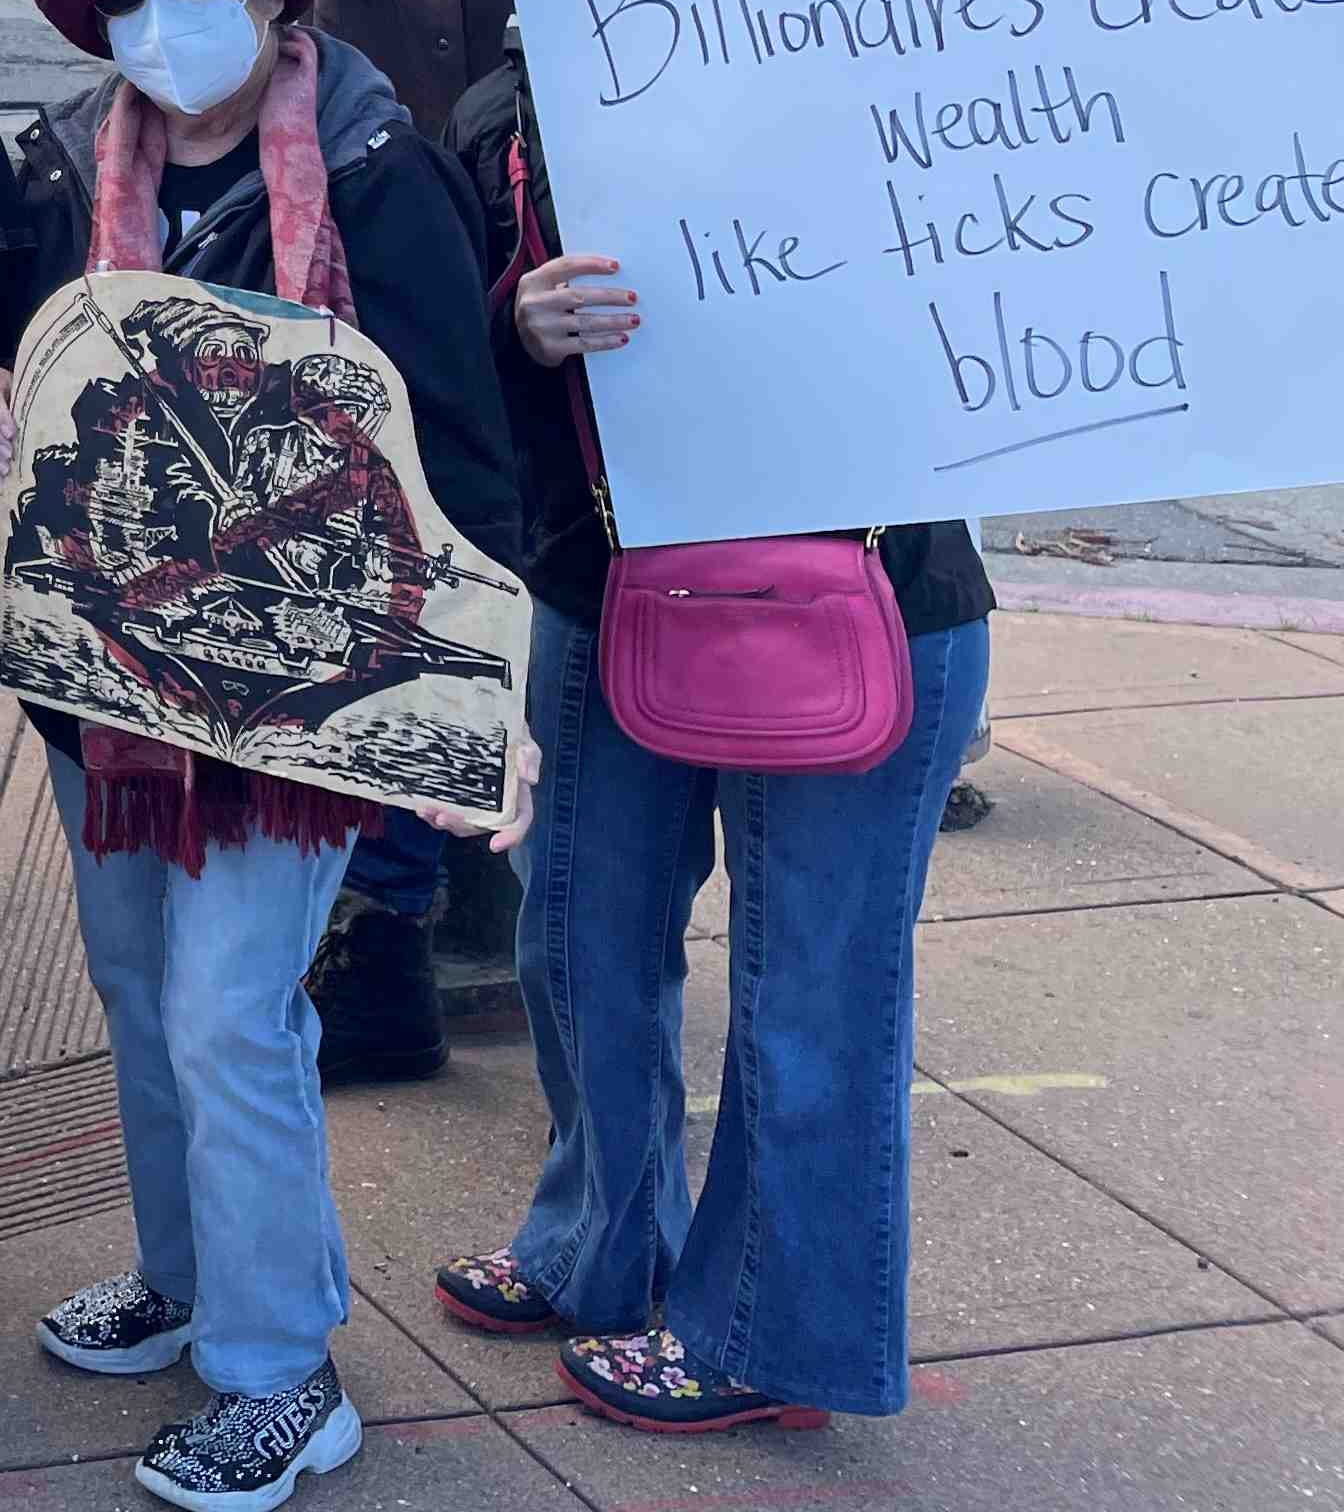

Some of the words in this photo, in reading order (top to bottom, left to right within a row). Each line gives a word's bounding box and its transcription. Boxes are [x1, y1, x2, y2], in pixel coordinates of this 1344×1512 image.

[679, 219, 847, 301] like
[882, 172, 1094, 277] ticks
[929, 271, 1189, 413] blood
[254, 1384, 326, 1460] GUESS
